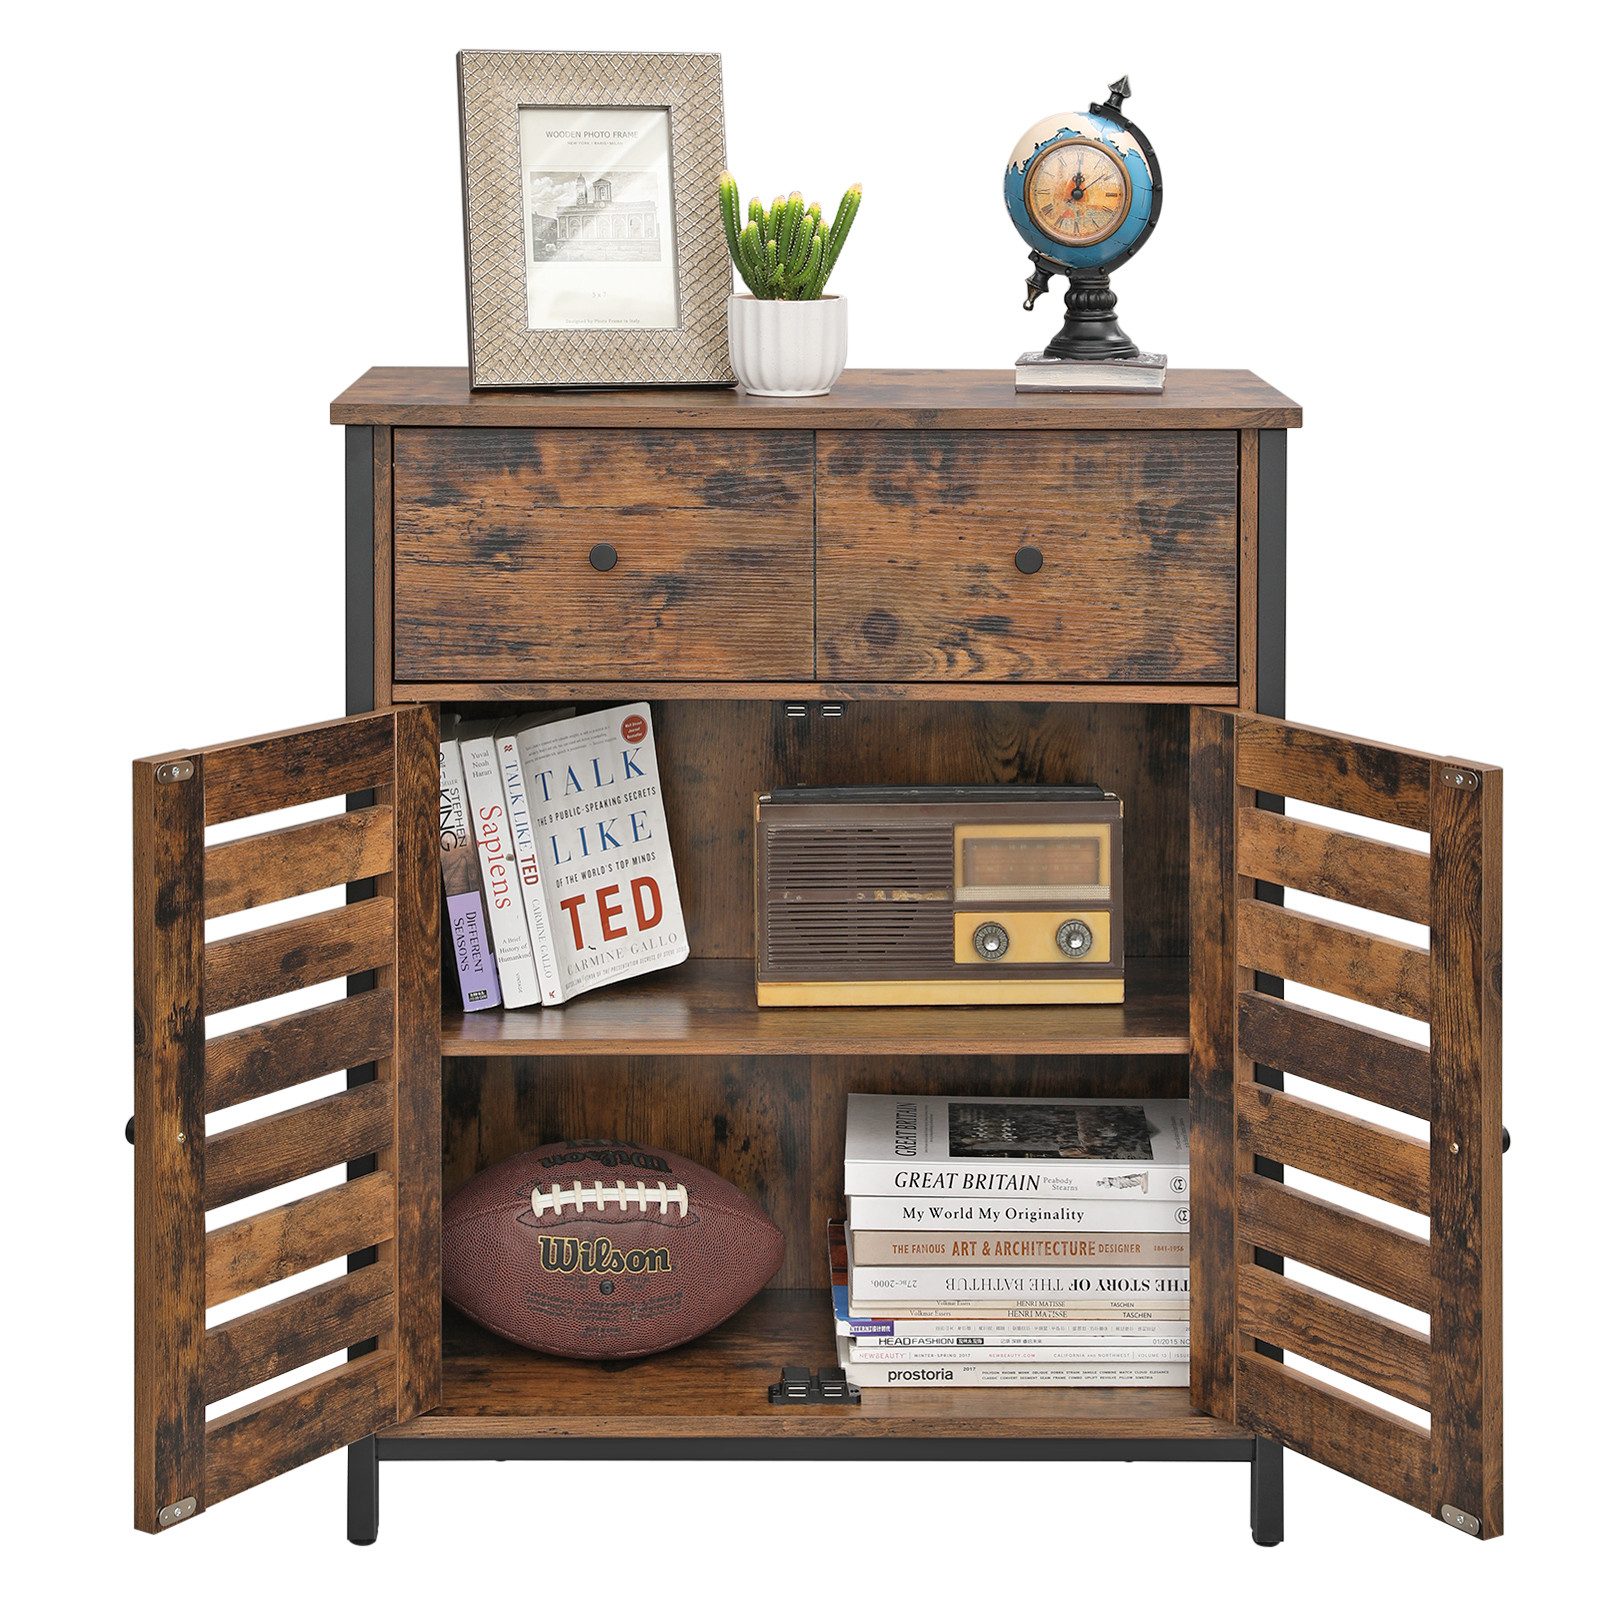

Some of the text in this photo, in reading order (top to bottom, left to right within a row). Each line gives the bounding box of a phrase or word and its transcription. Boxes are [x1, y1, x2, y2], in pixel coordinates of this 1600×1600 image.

[471, 751, 489, 759] Yuval
[472, 760, 489, 768] Noah
[534, 747, 647, 802] TALK
[440, 788, 458, 852] KING
[450, 787, 467, 848] STEPHEN
[505, 760, 539, 886] TALK LIKE TED
[537, 786, 656, 827] THE 9 PUBLIC-SPEAKING SECRETS
[477, 805, 512, 909] Sapiens
[549, 810, 653, 867] LIKE
[555, 851, 656, 889] OF THE WORLD'S TOP MINDS
[559, 875, 664, 951] TED
[454, 917, 470, 972] SEASONS
[465, 911, 484, 974] DIFFERENT
[498, 951, 532, 963] Humankind
[532, 898, 552, 979] CARMINE GALLO
[567, 933, 678, 977] CARMINE GALLO
[895, 1102, 917, 1156] GREAT BRITAIN
[894, 1171, 1040, 1191] GREAT BRITAIN
[1043, 1176, 1073, 1185] Peabody
[902, 1206, 1085, 1223] My World My Originality
[537, 1234, 672, 1275] Wilson
[892, 1244, 909, 1254] THE
[952, 1241, 978, 1256] ART
[982, 1241, 991, 1256] &
[994, 1241, 1096, 1256] ARCHITECTURE
[1098, 1243, 1141, 1253] DESIGNER
[945, 1278, 1024, 1291] BATHTUB
[1028, 1278, 1064, 1291] THE
[1068, 1279, 1091, 1291] OF
[1096, 1279, 1151, 1292] STORY
[1155, 1279, 1190, 1292] THE
[1007, 1310, 1033, 1318] HENRI
[1034, 1310, 1068, 1318] MATISSE
[887, 1367, 954, 1382] prostoria
